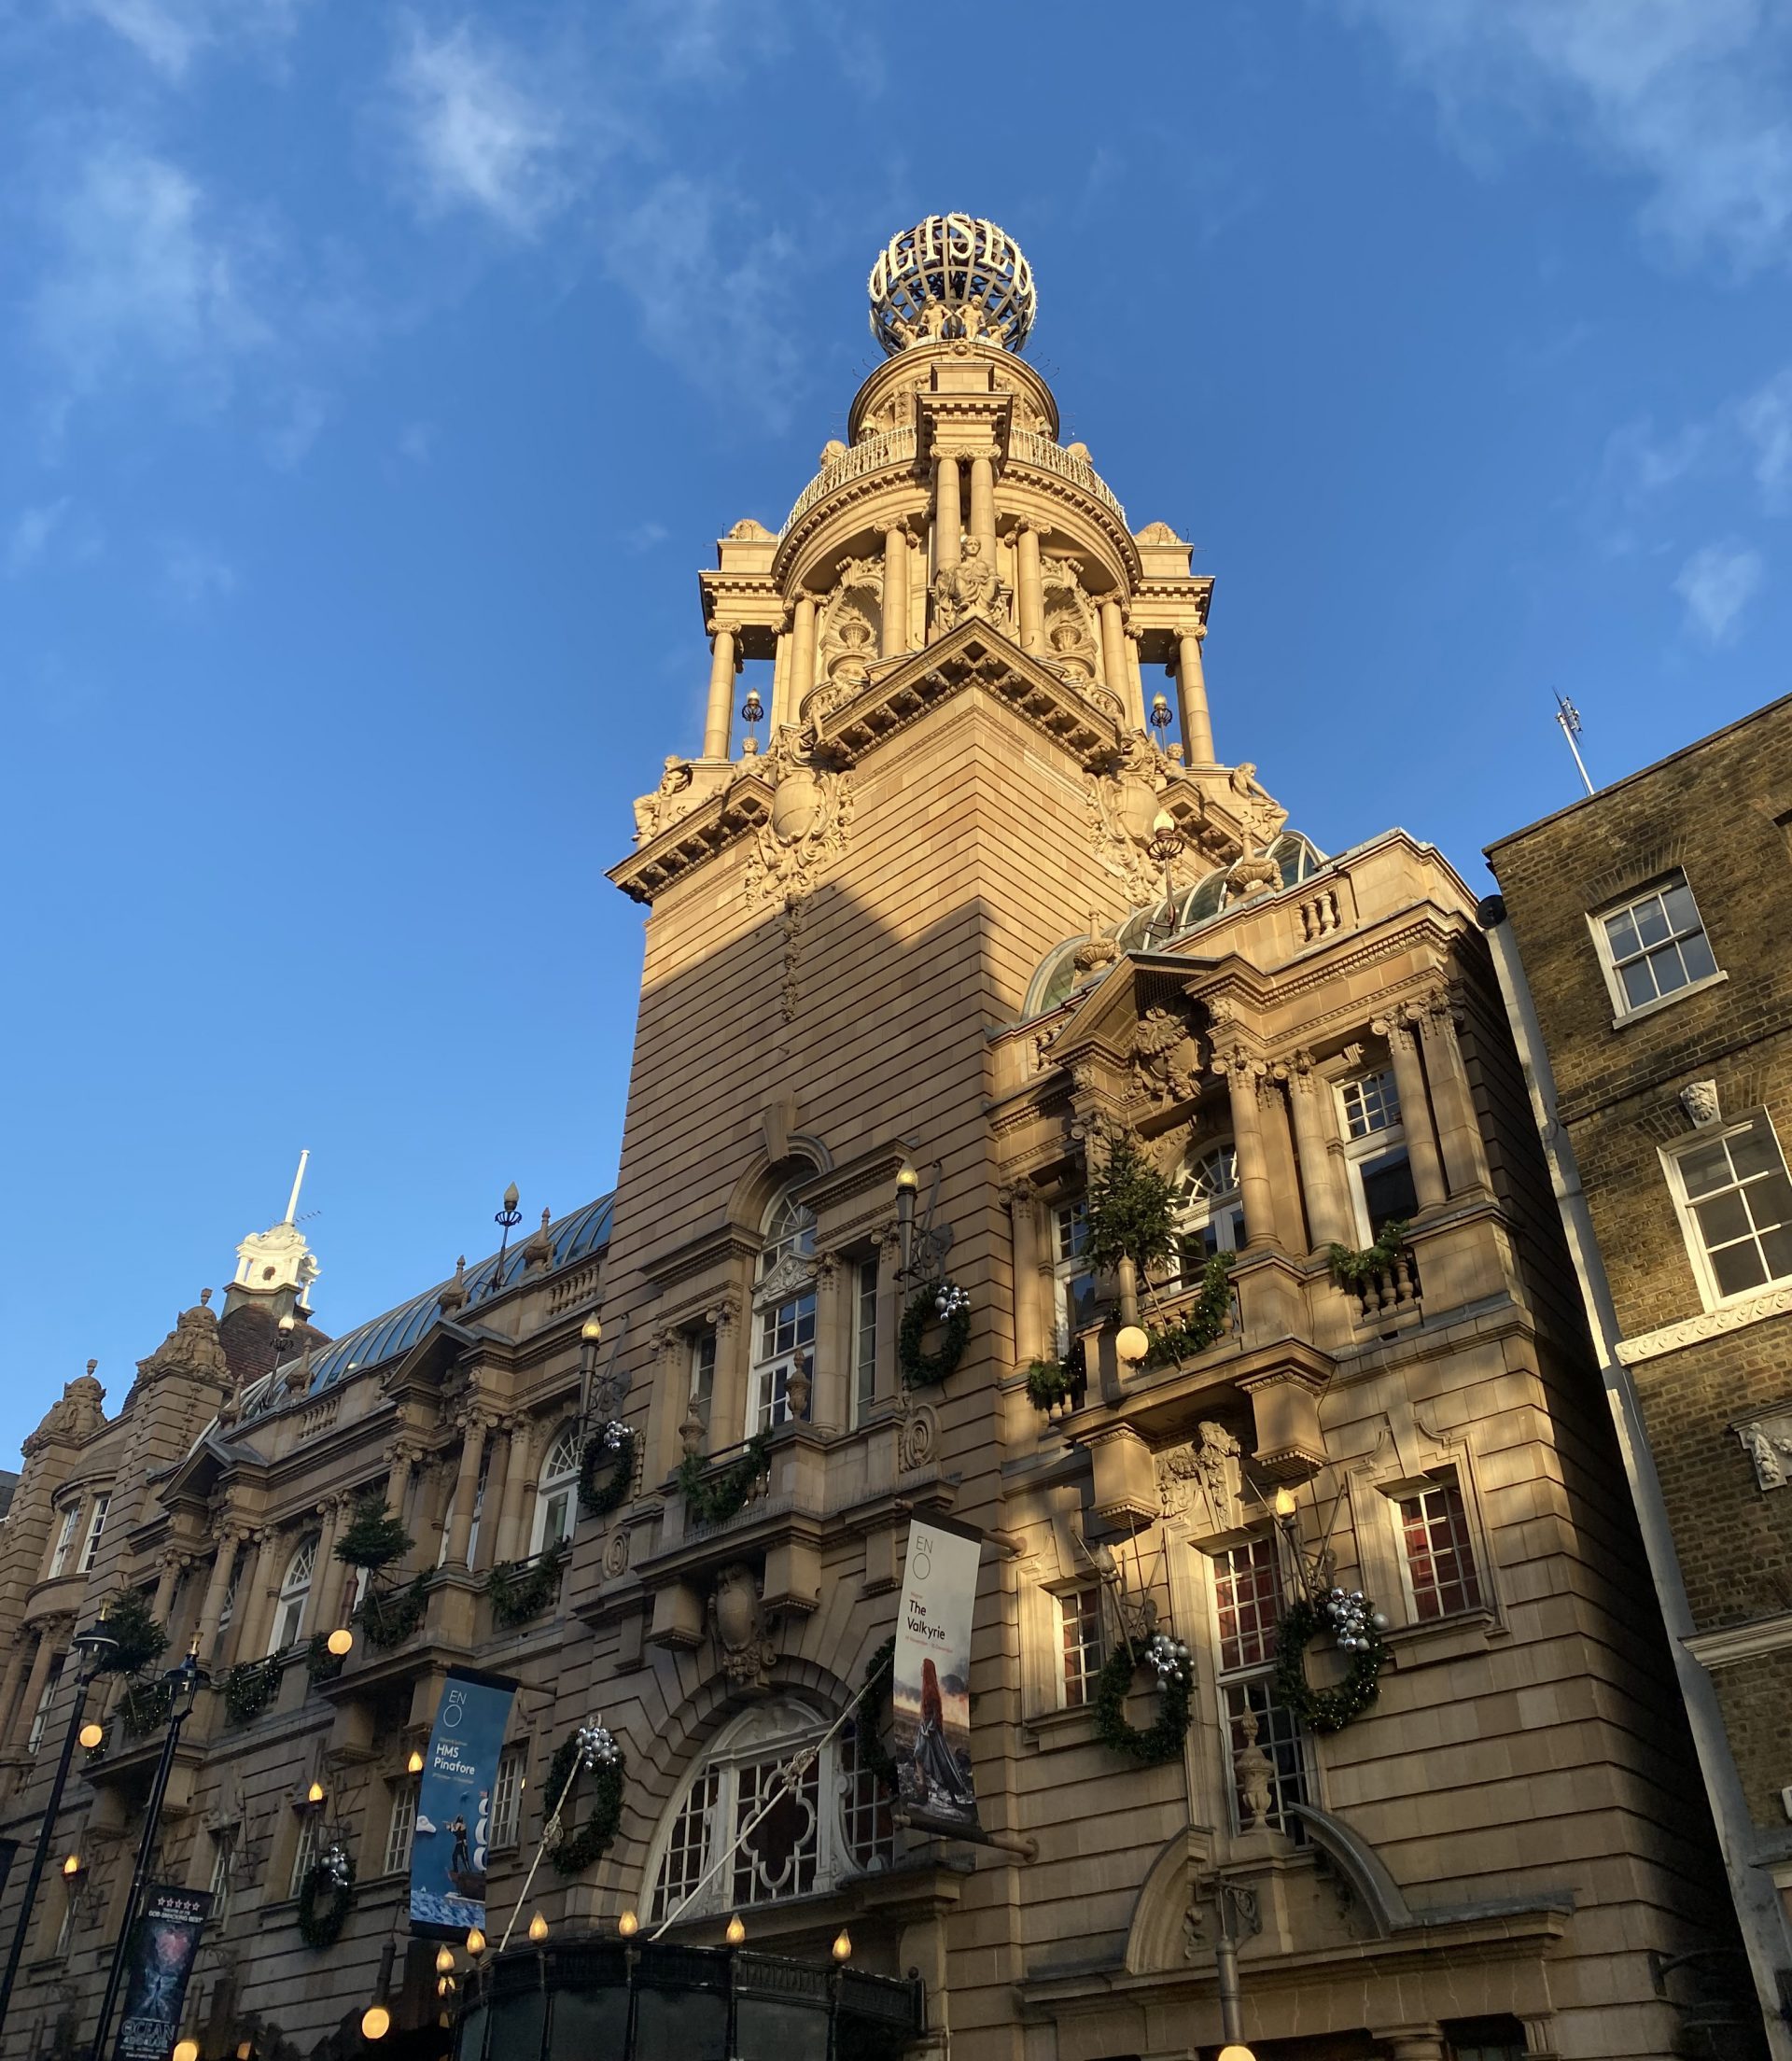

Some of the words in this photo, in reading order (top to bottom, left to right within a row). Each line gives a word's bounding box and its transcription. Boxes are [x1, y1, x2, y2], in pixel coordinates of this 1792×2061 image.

[916, 1535, 933, 1553] EN
[913, 1552, 931, 1579] O
[909, 1599, 927, 1616] The
[907, 1616, 945, 1640] Valkyrie
[448, 1689, 467, 1705] EN
[443, 1703, 462, 1727] O
[436, 1743, 459, 1758] HMS
[433, 1757, 475, 1775] Pinafore
